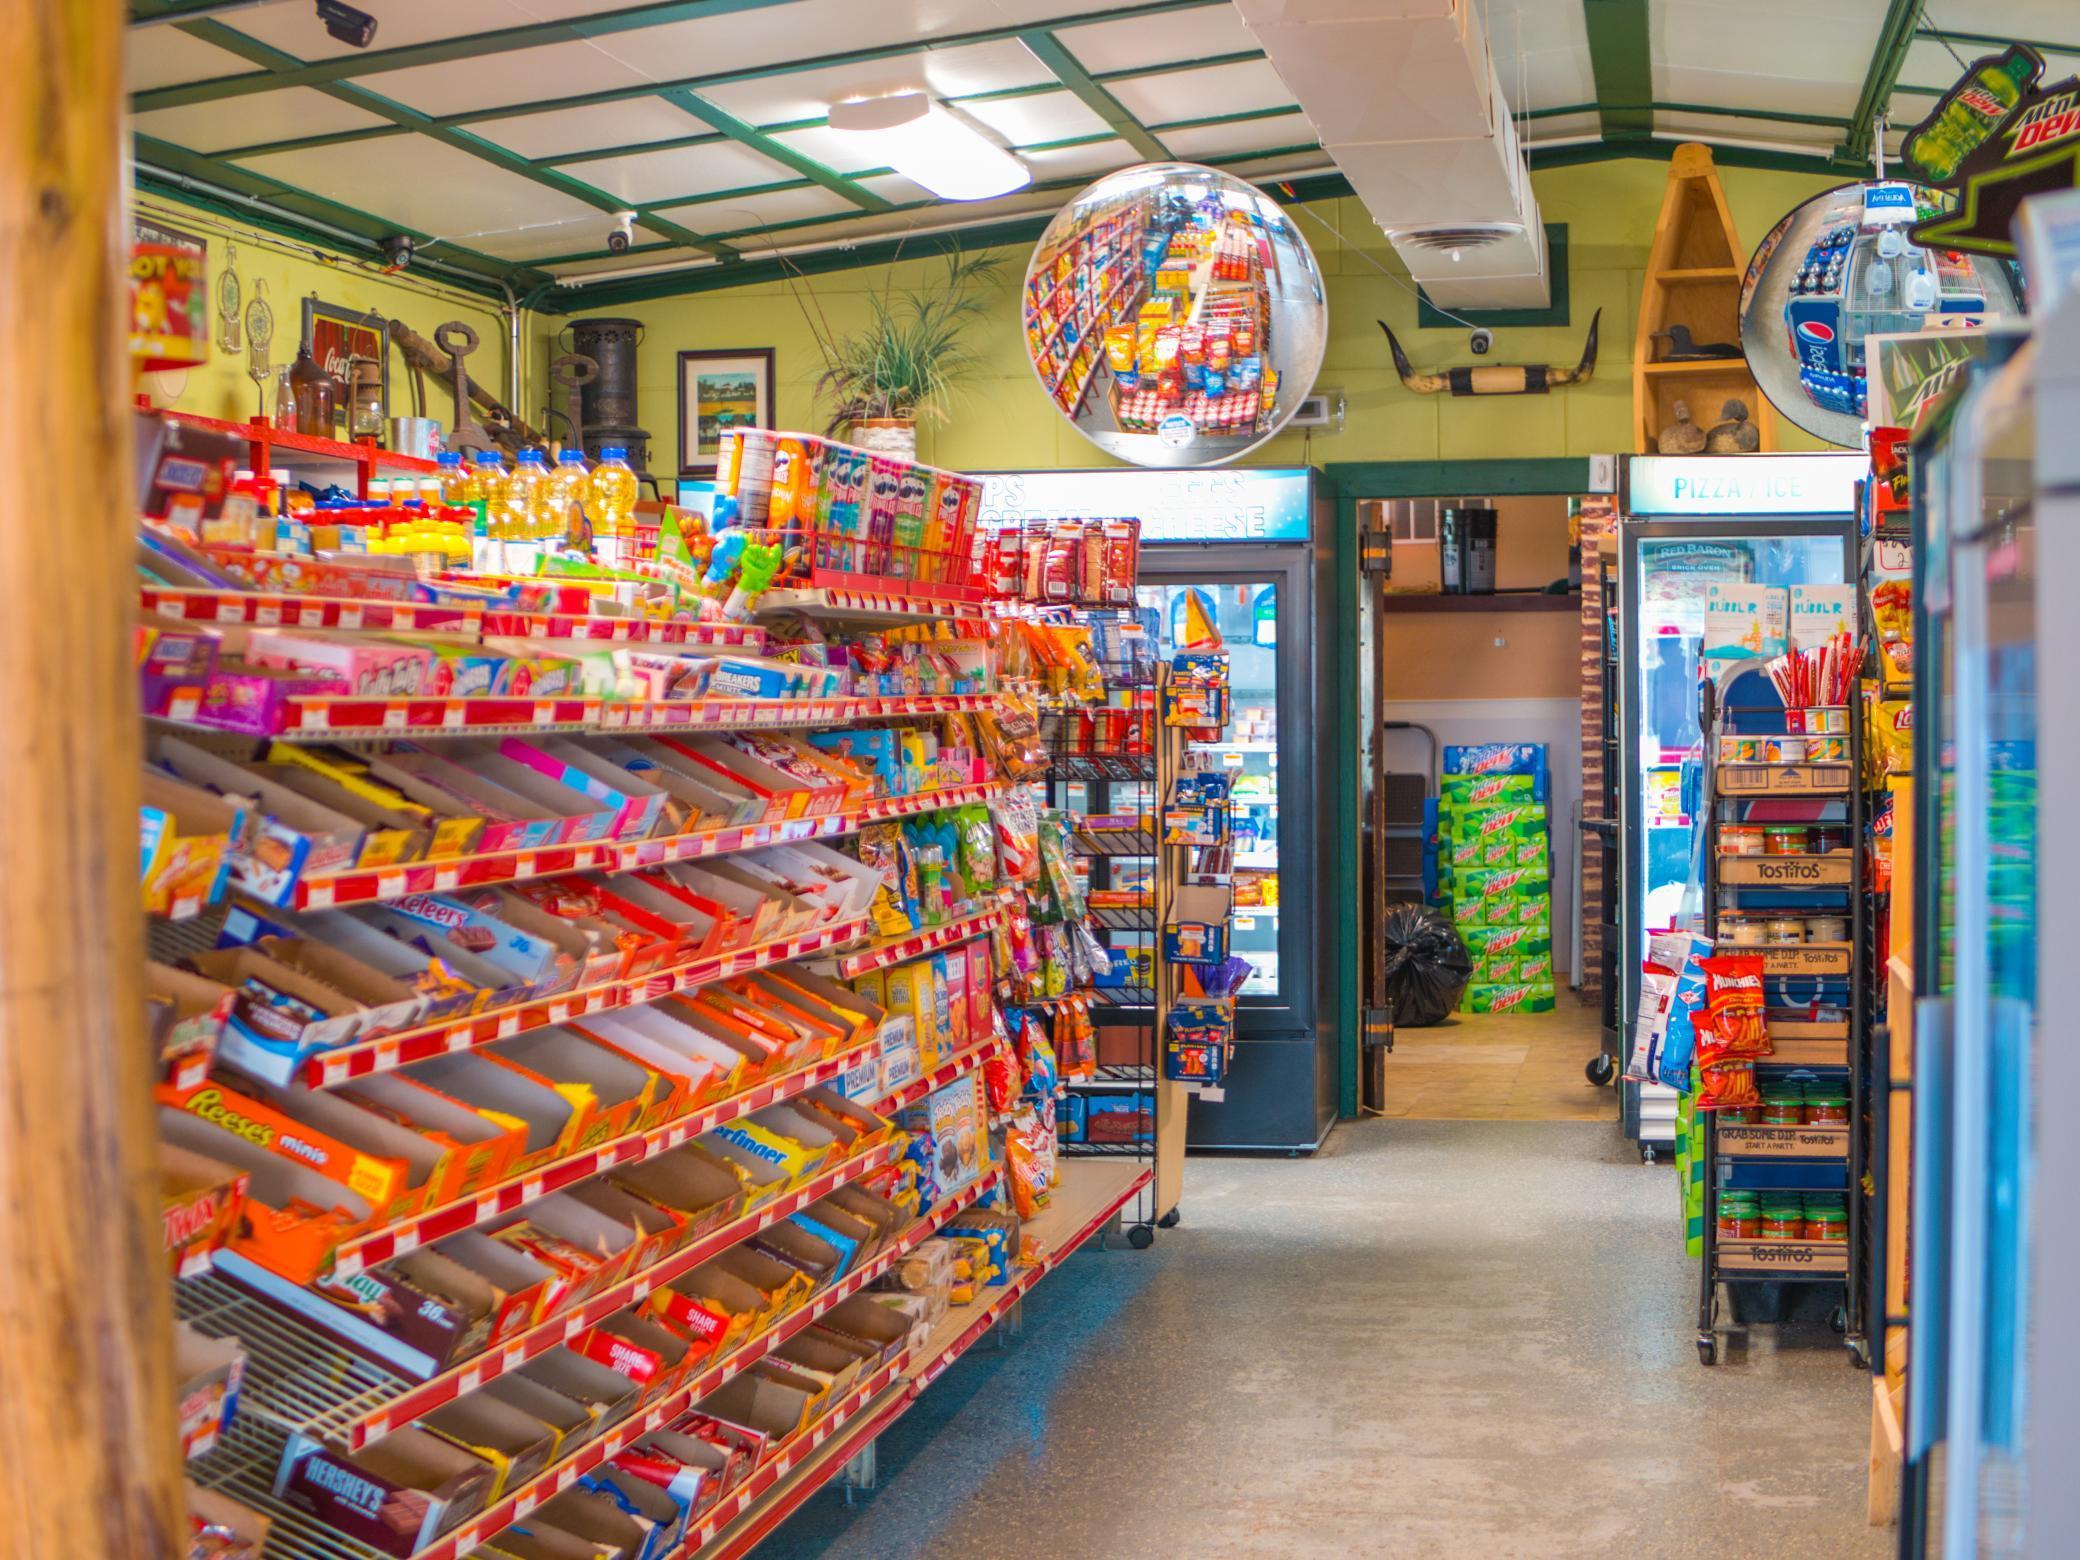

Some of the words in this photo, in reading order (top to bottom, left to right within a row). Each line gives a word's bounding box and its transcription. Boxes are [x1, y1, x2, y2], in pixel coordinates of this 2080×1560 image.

[1675, 478, 1741, 498] PIZZA
[1768, 477, 1803, 497] ICE
[1687, 543, 1731, 558] BARON
[1713, 974, 1761, 991] MUNCHIES
[846, 1064, 875, 1089] PREMIUM
[186, 1088, 275, 1147] Reese's
[279, 1134, 329, 1165] minis
[1750, 1129, 1776, 1140] SOME
[686, 1308, 718, 1334] SHARE
[609, 1343, 648, 1369] SHARE
[305, 1456, 386, 1512] HERSHEY'S
